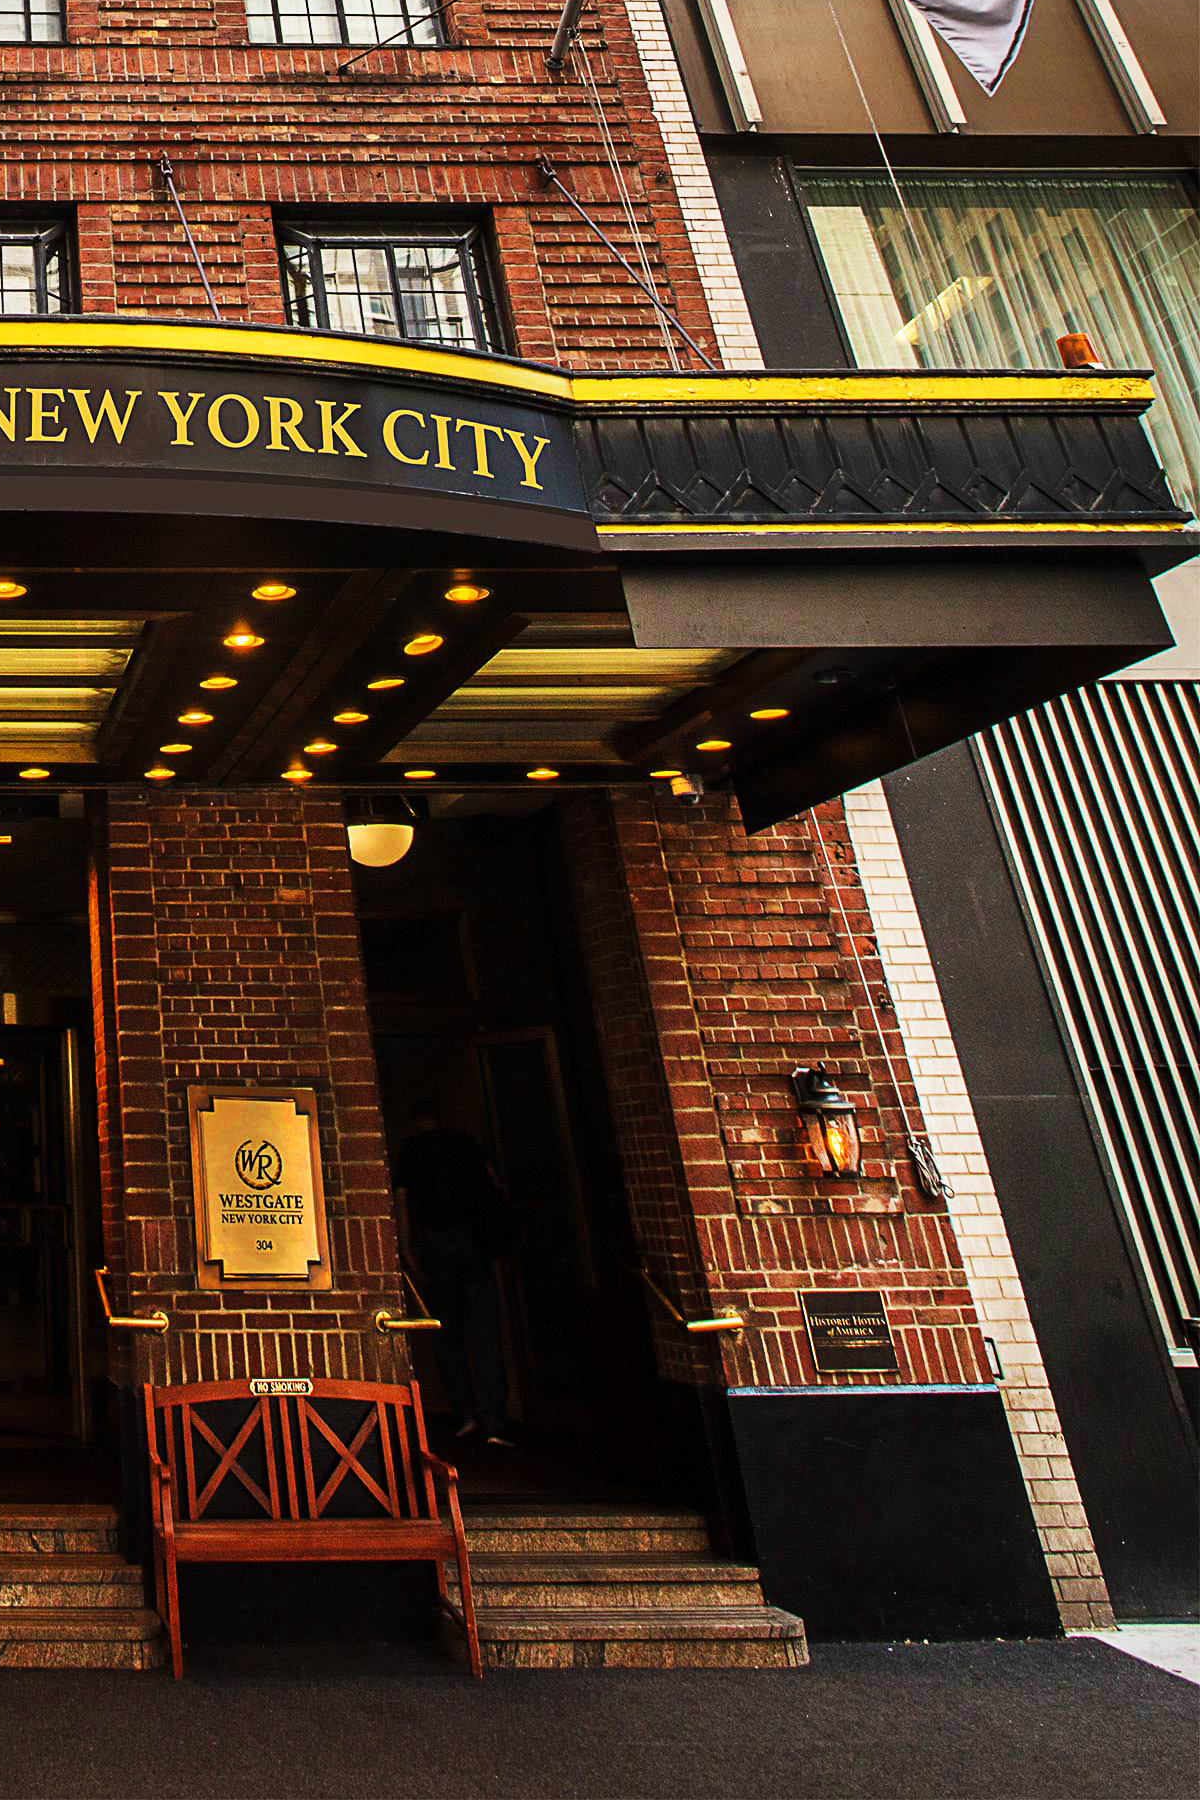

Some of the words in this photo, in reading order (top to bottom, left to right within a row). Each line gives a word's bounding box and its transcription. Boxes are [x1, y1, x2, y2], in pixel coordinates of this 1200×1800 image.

[157, 390, 368, 459] YORK
[382, 408, 552, 491] CITY
[219, 1193, 304, 1209] WESTGATE
[221, 1213, 247, 1224] NEW
[248, 1213, 278, 1225] YORK
[279, 1214, 303, 1225] CITY
[256, 1239, 273, 1251] 304
[256, 1382, 269, 1392] NO
[270, 1382, 306, 1393] SMOKING
